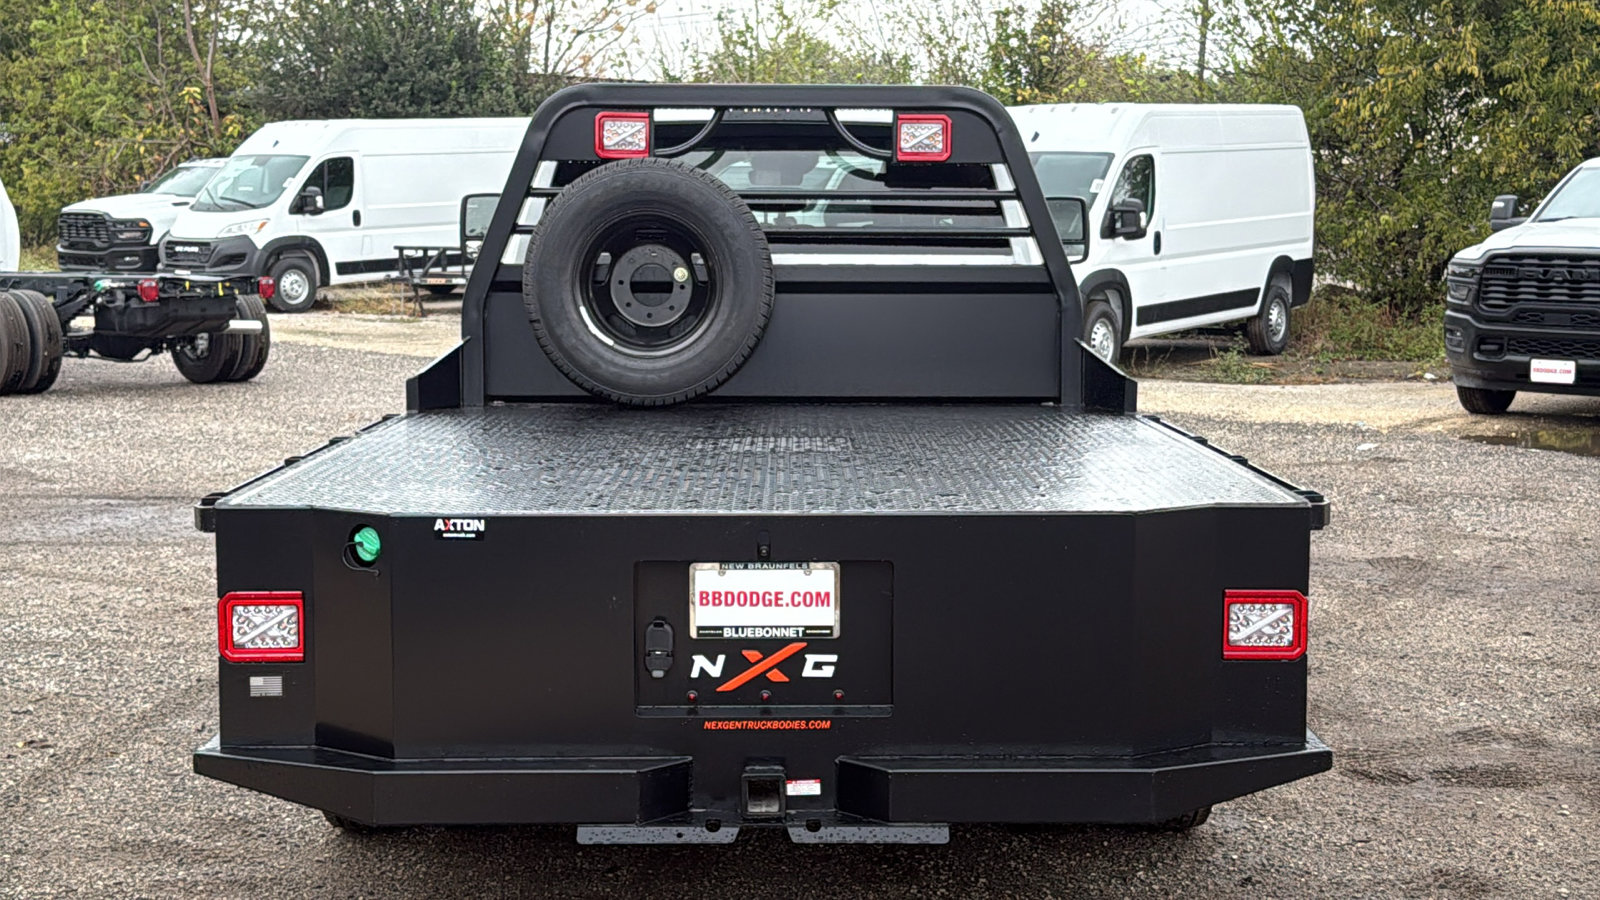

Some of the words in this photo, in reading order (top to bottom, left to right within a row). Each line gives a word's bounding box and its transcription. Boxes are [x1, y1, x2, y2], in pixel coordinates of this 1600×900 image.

[433, 518, 485, 531] AXTON
[721, 562, 745, 570] NEW
[748, 562, 808, 570] BRAUNFELS
[699, 590, 831, 608] BBDODGE.COM
[723, 627, 805, 638] BLUEBONNET
[704, 719, 831, 730] NEXGENTRUCKBODIES.COM
